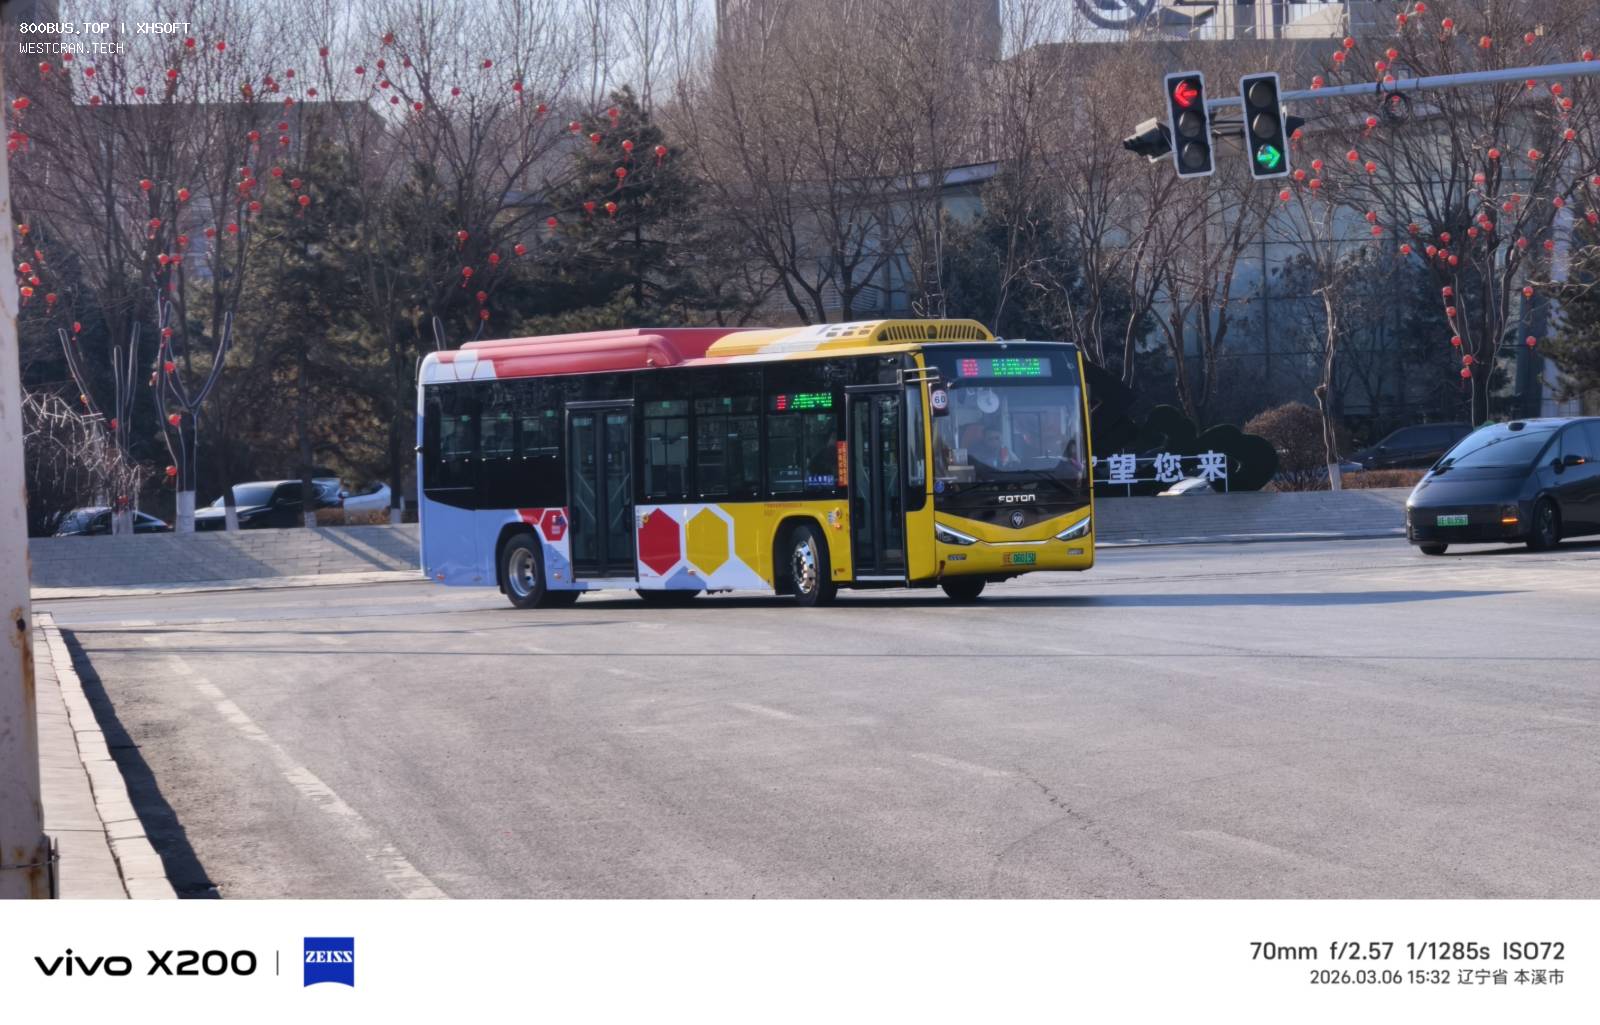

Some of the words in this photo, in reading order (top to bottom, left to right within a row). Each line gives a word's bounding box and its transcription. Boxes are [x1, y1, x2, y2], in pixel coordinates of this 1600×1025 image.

[934, 395, 946, 404] 60
[1092, 450, 1226, 484] 望您来
[998, 494, 1036, 503] FOTON
